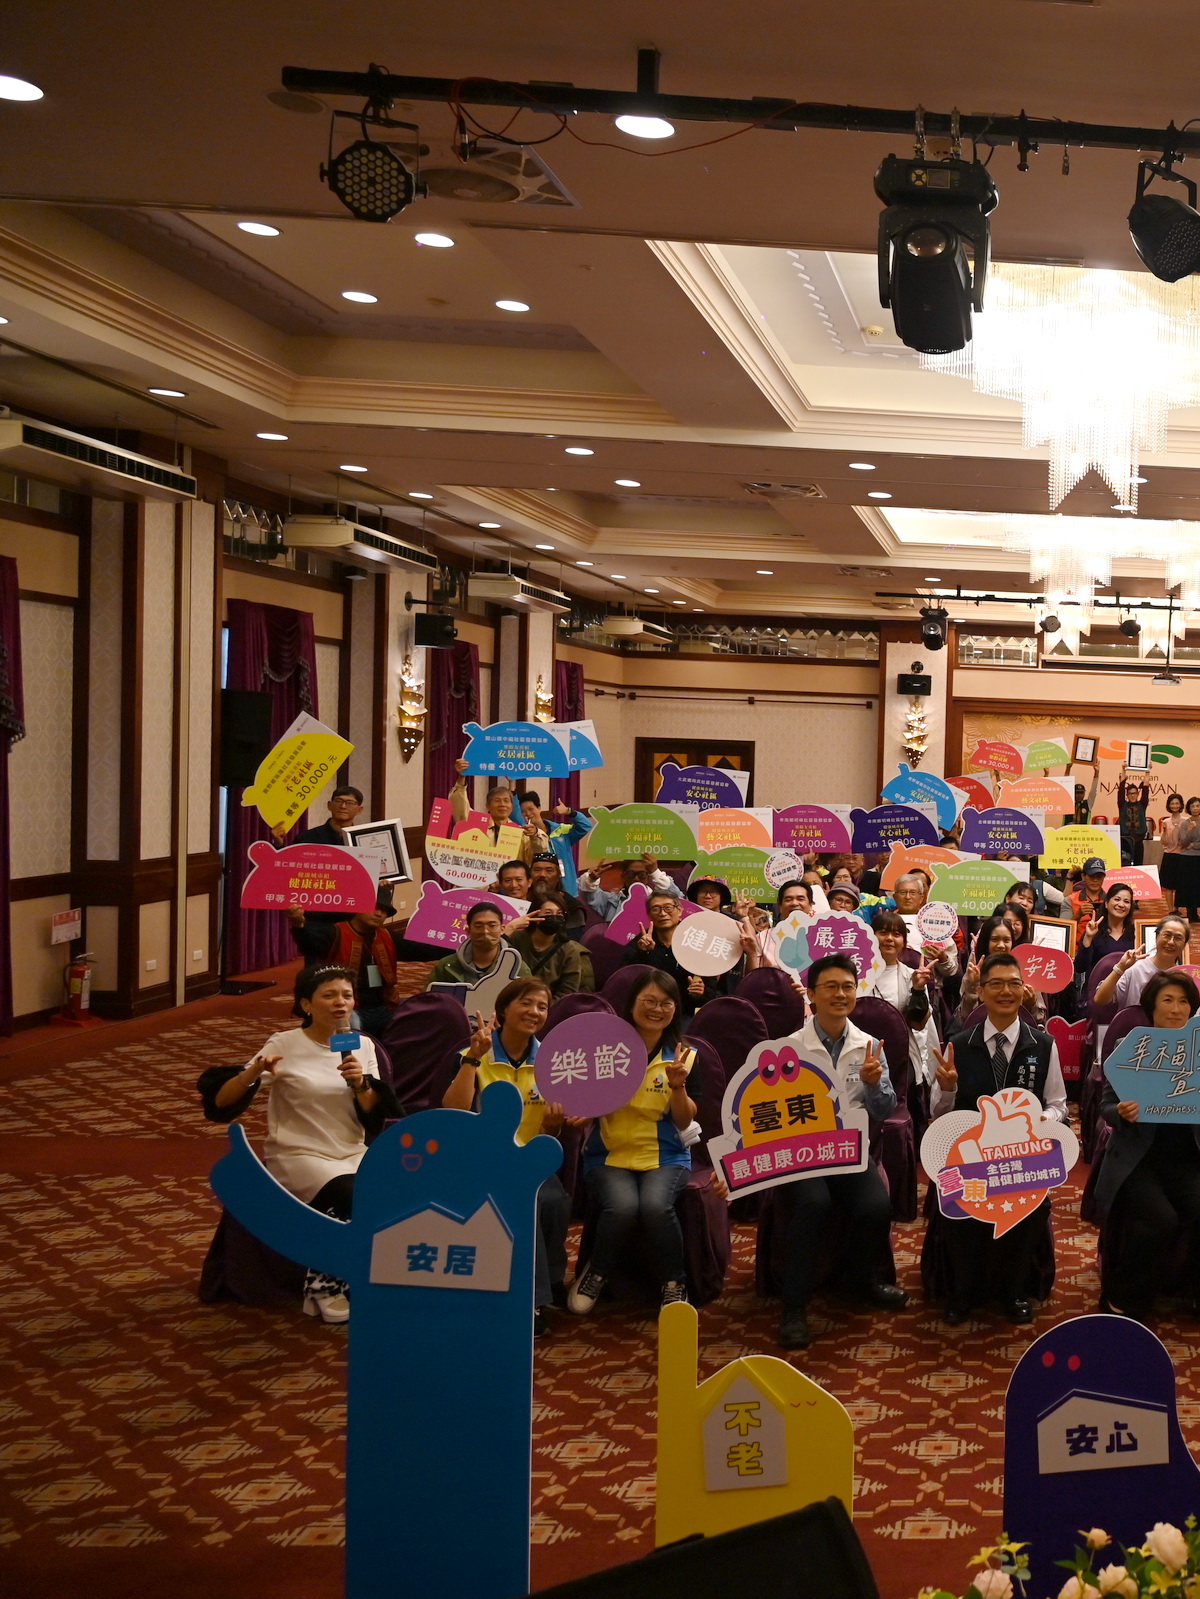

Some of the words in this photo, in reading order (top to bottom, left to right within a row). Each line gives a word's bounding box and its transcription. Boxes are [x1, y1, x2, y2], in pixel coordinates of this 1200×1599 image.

[497, 750, 536, 759] 安居社區
[479, 763, 496, 771] 特優
[498, 761, 542, 772] 40,000
[988, 760, 1010, 770] 30,000
[1038, 759, 1057, 767] 20,000
[286, 760, 314, 793] 不老社區
[285, 802, 299, 817] 優等
[296, 763, 329, 801] 30,000
[328, 754, 337, 763] 元
[686, 789, 718, 800] 安心社區
[625, 832, 662, 842] 幸福社區
[706, 832, 742, 841] 藝文社區
[790, 829, 822, 837] 友善社區
[879, 828, 910, 837] 安心社區
[987, 831, 1018, 839] 安心社區
[605, 846, 621, 854] 佳作
[672, 847, 680, 855] 元
[792, 839, 827, 849] 10,000
[989, 841, 1022, 850] 20,000
[289, 878, 337, 890] 健康社區
[265, 893, 285, 903] 甲等
[289, 892, 342, 905] 20,000
[346, 897, 355, 906] 元
[768, 890, 776, 898] 元
[962, 888, 996, 899] 幸福社區
[427, 929, 446, 940] 優等
[813, 926, 860, 951] 嚴重
[680, 926, 735, 961] 健康
[1024, 954, 1057, 980] 安居
[550, 1042, 631, 1085] 樂齡
[1063, 1065, 1081, 1074] 優等
[1017, 1065, 1026, 1085] 局長
[749, 1093, 819, 1134] 臺東
[1144, 1102, 1196, 1117] Happiness
[983, 1138, 1054, 1161] TAITUNG
[731, 1140, 856, 1181] 最健康の城市
[986, 1160, 1024, 1176] 全台灣
[988, 1167, 1061, 1188] 最健康的城市
[937, 1167, 988, 1202] 臺東
[406, 1243, 477, 1276] 安居
[725, 1401, 764, 1477] 不老
[1066, 1421, 1138, 1456] 安心
